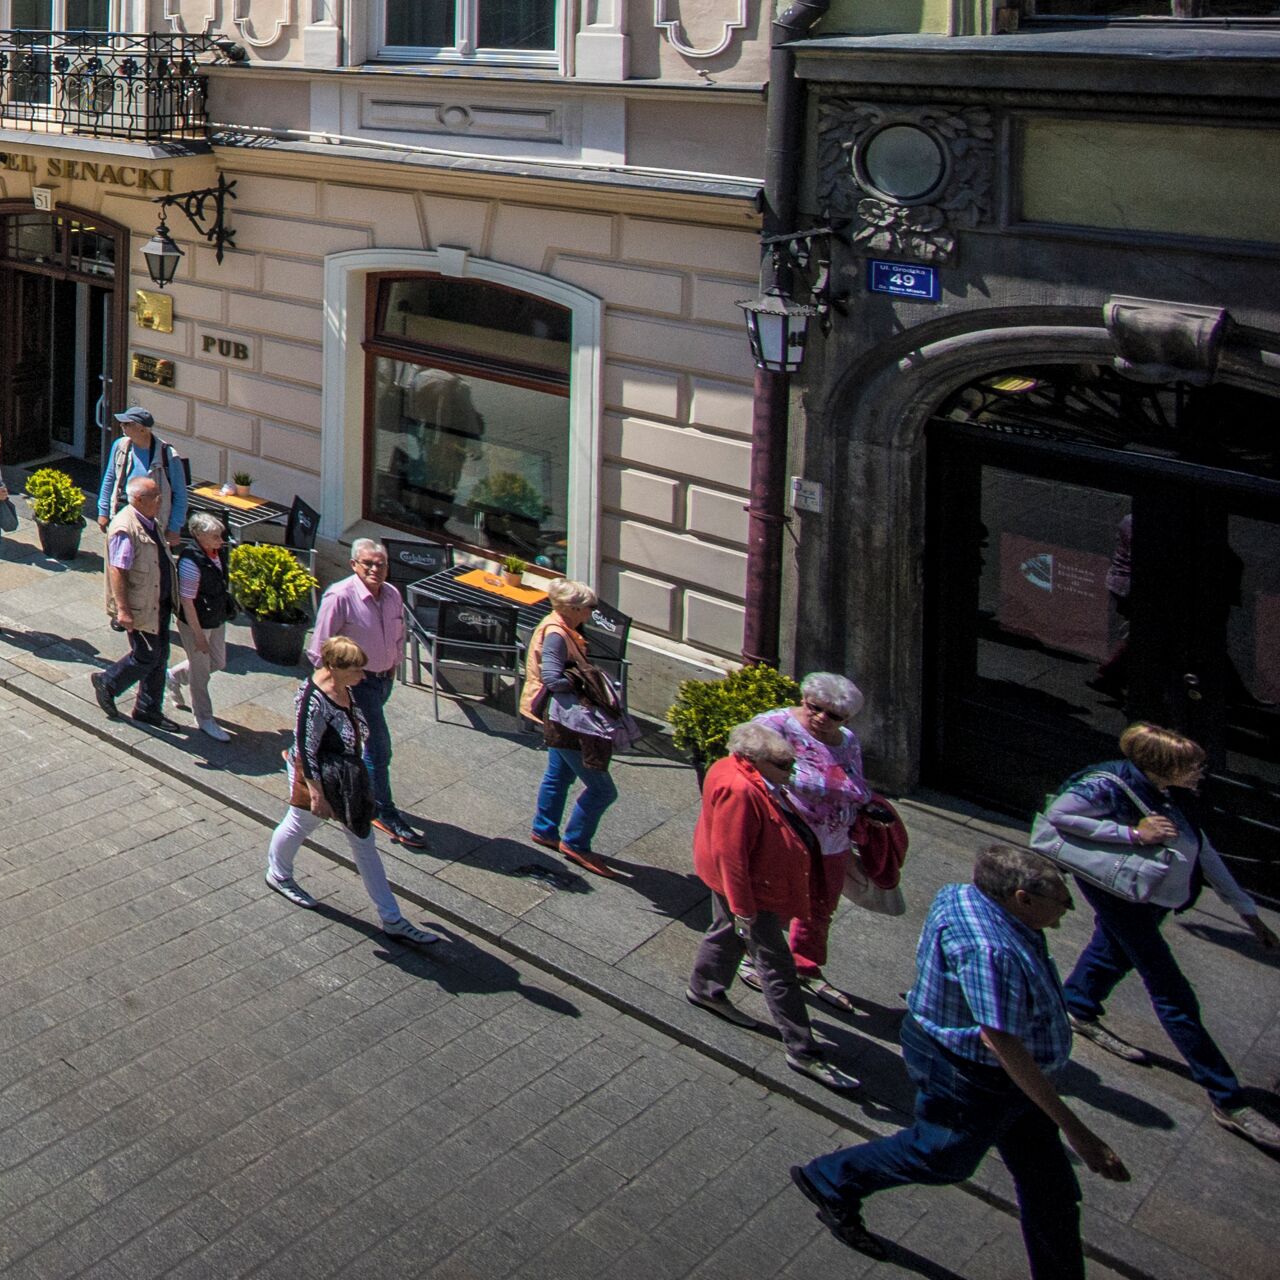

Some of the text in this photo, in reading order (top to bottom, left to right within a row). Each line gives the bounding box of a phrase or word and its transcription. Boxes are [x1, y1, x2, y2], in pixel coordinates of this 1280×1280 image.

[47, 158, 174, 192] SENACKI
[35, 193, 48, 209] 51
[893, 266, 926, 275] Grodzka
[889, 273, 915, 286] 49
[201, 334, 249, 360] PUB
[399, 550, 436, 566] Carlsberg
